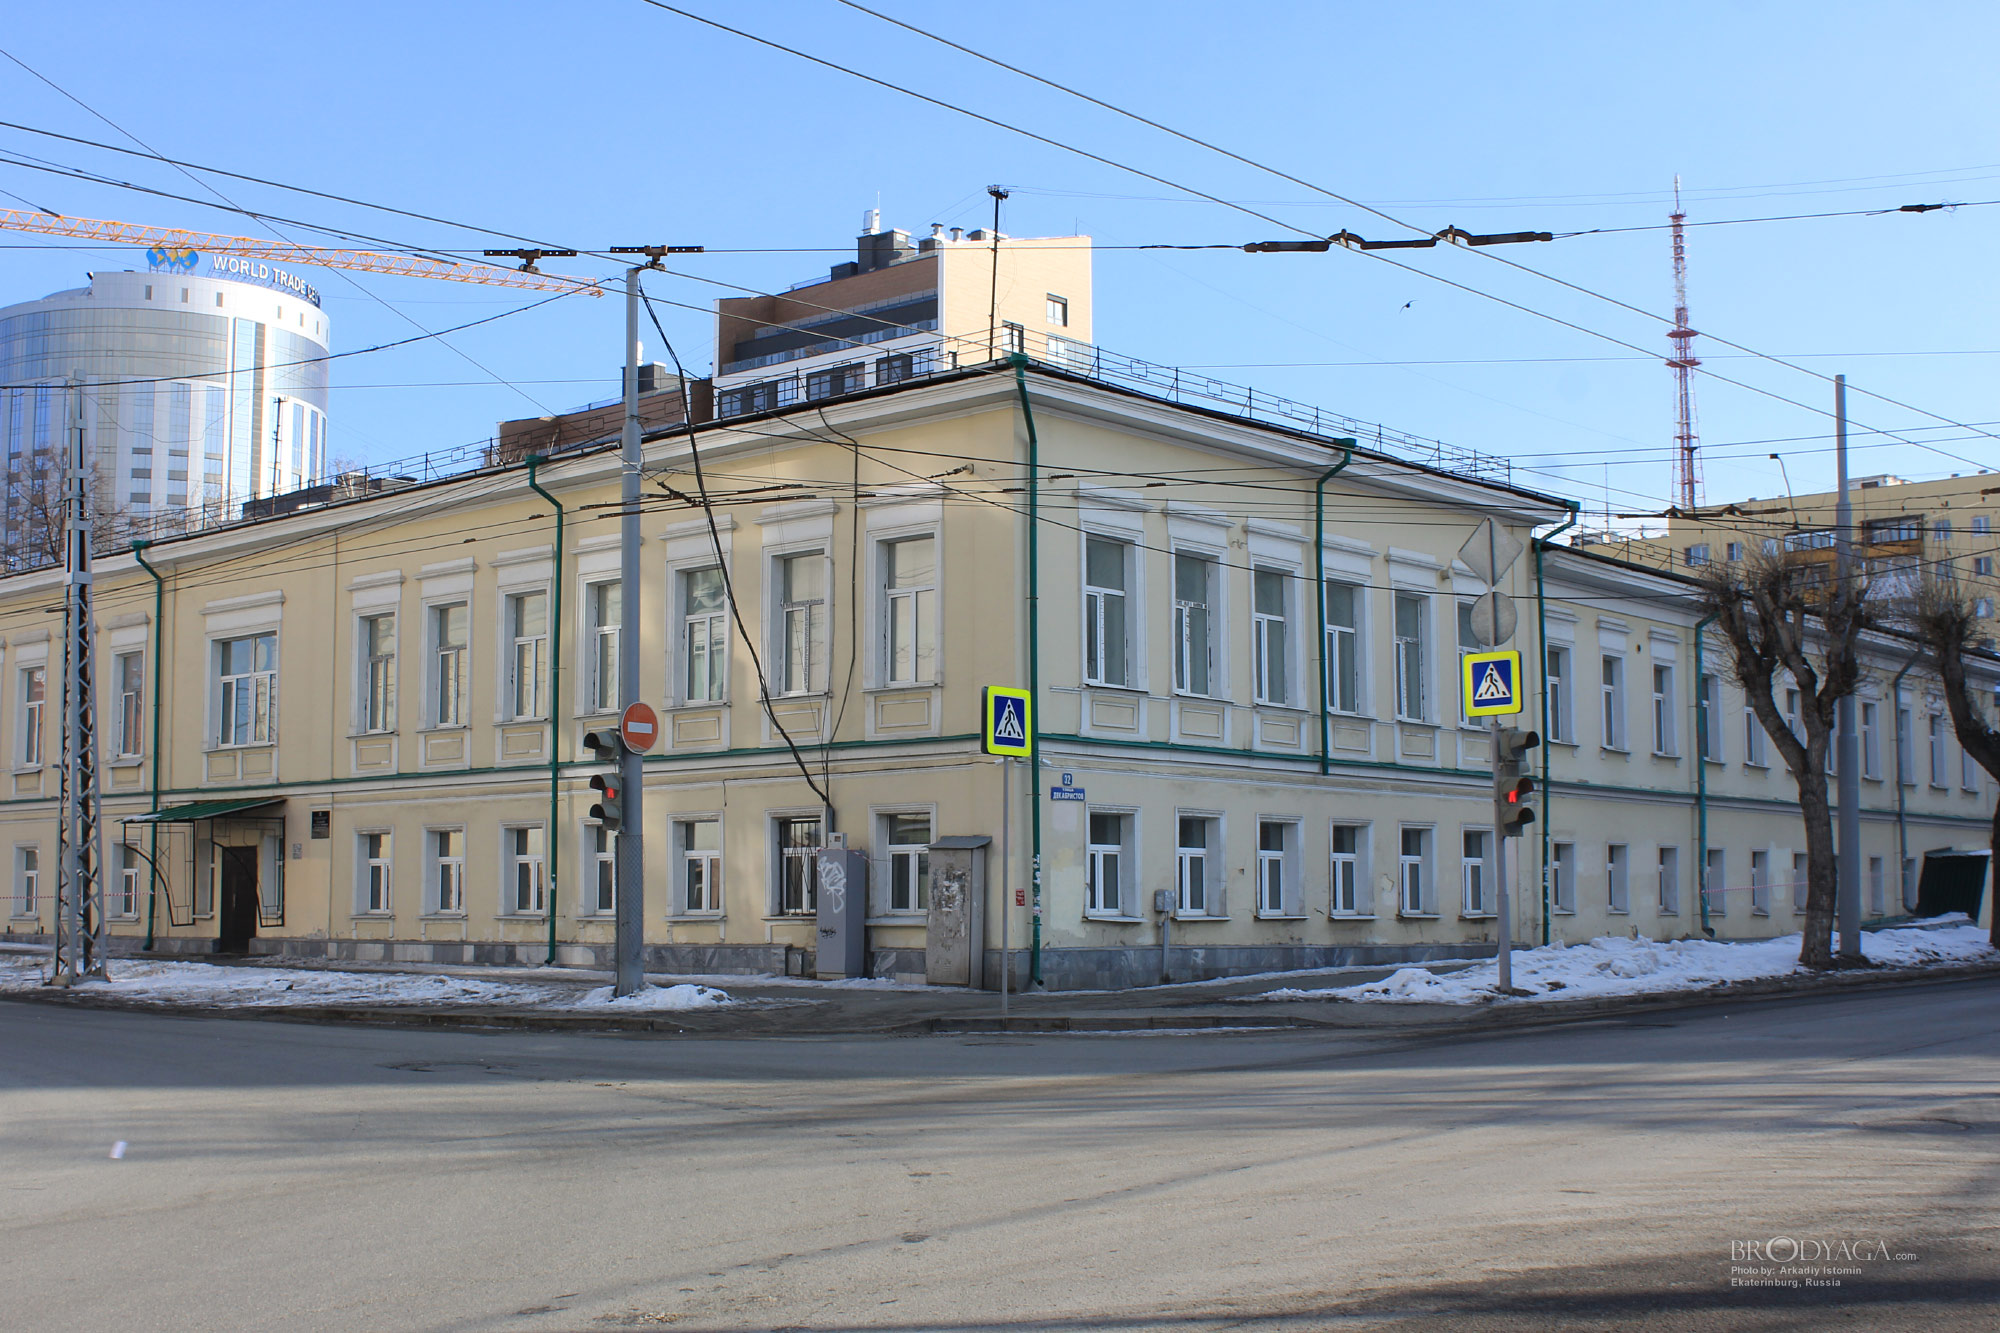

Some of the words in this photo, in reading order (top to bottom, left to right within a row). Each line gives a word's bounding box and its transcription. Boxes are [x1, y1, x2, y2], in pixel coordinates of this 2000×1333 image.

[213, 255, 269, 280] WORLD
[272, 267, 306, 295] TRADE
[1064, 774, 1071, 784] 32
[1053, 791, 1084, 799] ДЕКАБРИСТОВ
